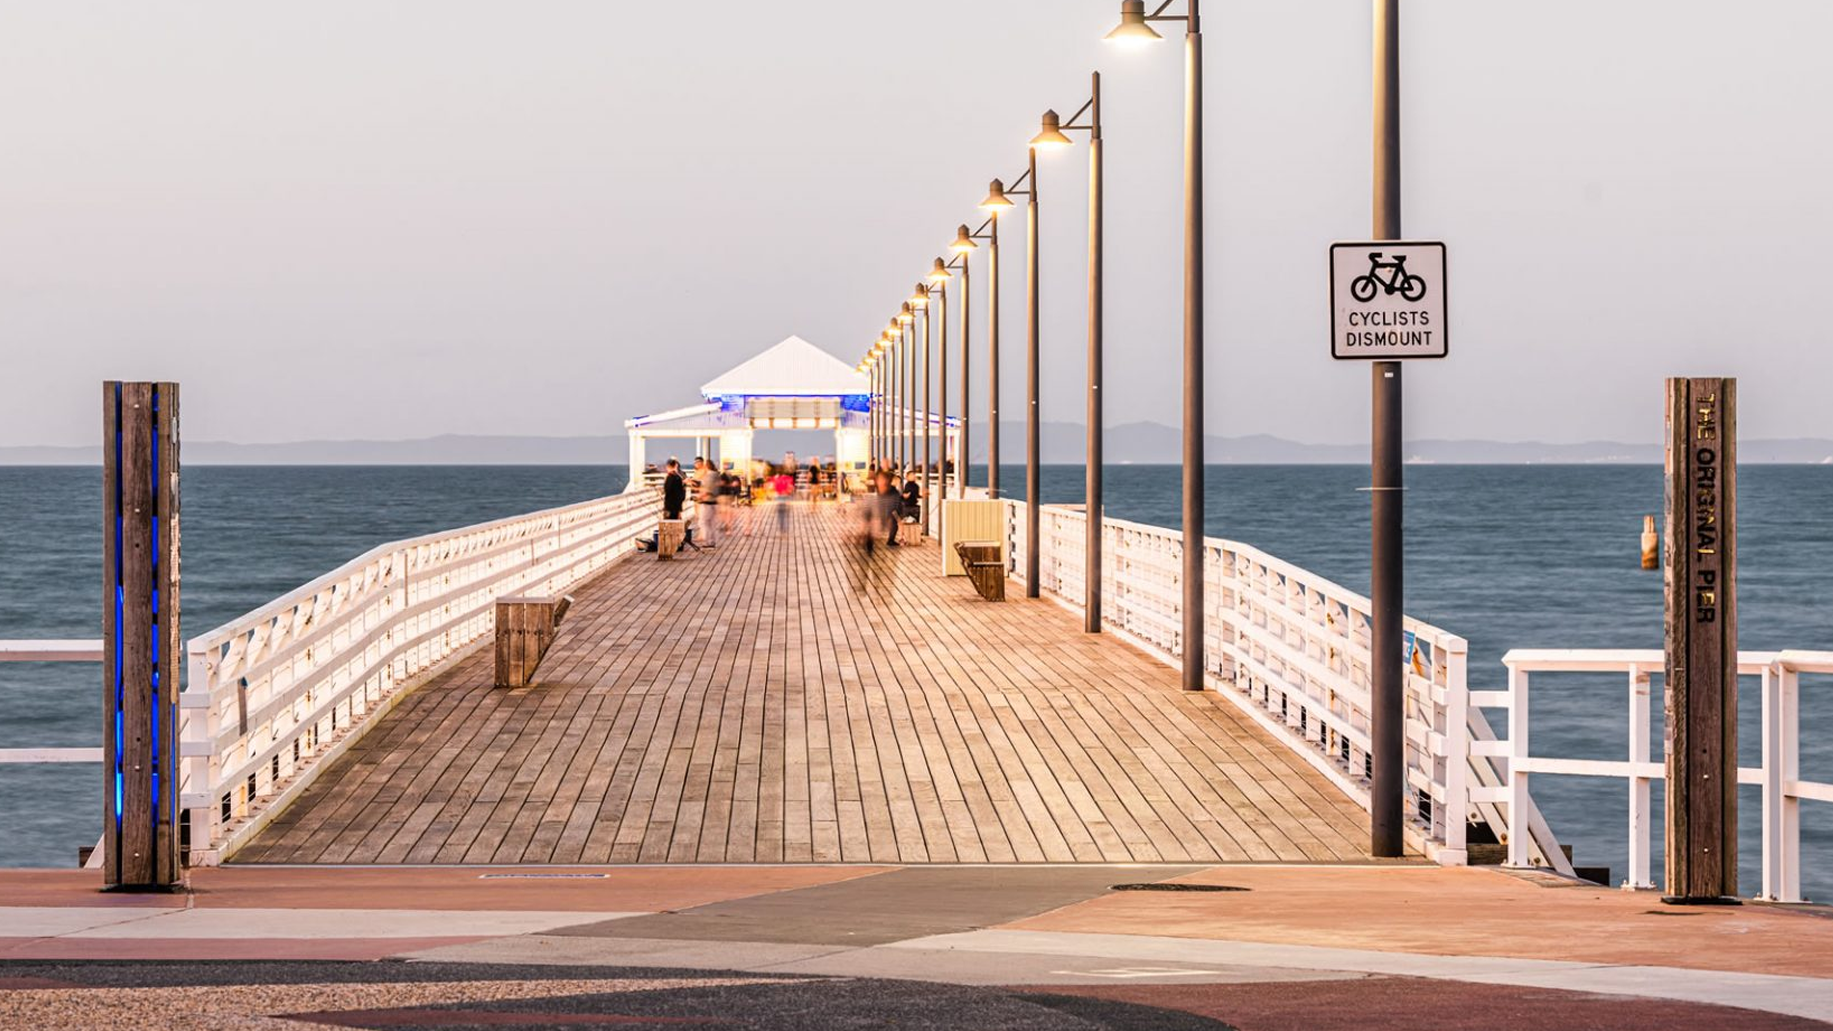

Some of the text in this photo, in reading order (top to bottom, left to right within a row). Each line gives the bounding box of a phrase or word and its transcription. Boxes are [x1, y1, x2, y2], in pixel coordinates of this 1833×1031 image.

[1349, 311, 1429, 326] CYCLISTS
[1346, 331, 1432, 347] DISMOUNT
[1697, 393, 1716, 623] THE ORIGINAL PIER
